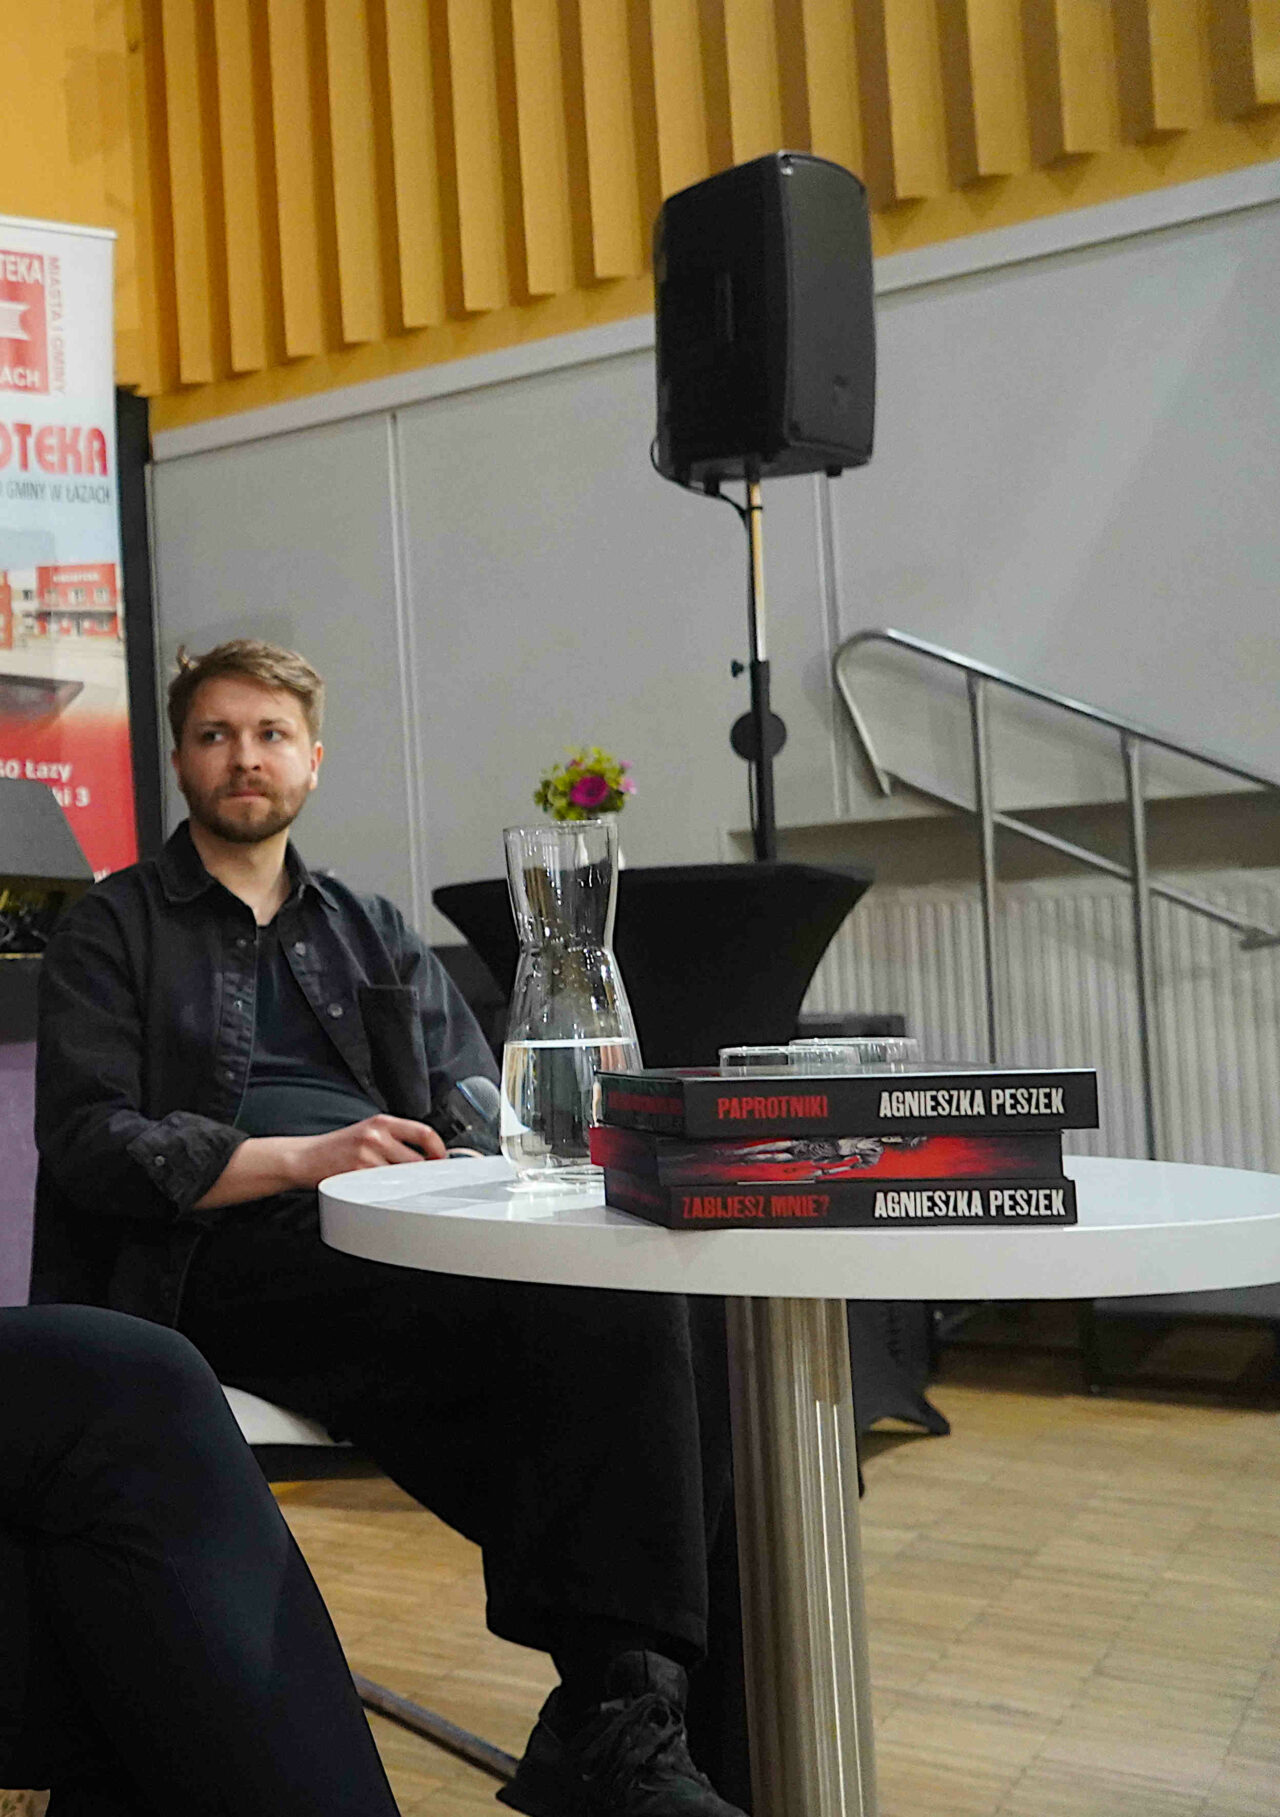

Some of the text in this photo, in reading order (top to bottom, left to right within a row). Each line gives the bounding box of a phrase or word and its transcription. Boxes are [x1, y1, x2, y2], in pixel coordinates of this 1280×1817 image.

[49, 256, 63, 320] MIASTA
[7, 480, 46, 500] GMINY
[75, 786, 91, 808] 3
[718, 1096, 828, 1119] PAPROTNIKI
[879, 1088, 1065, 1118] AGNIESZKA PESZEK
[683, 1195, 830, 1219] ZABIJESZ MNIE?
[874, 1189, 1066, 1218] AGNIESZKA PESZEK
